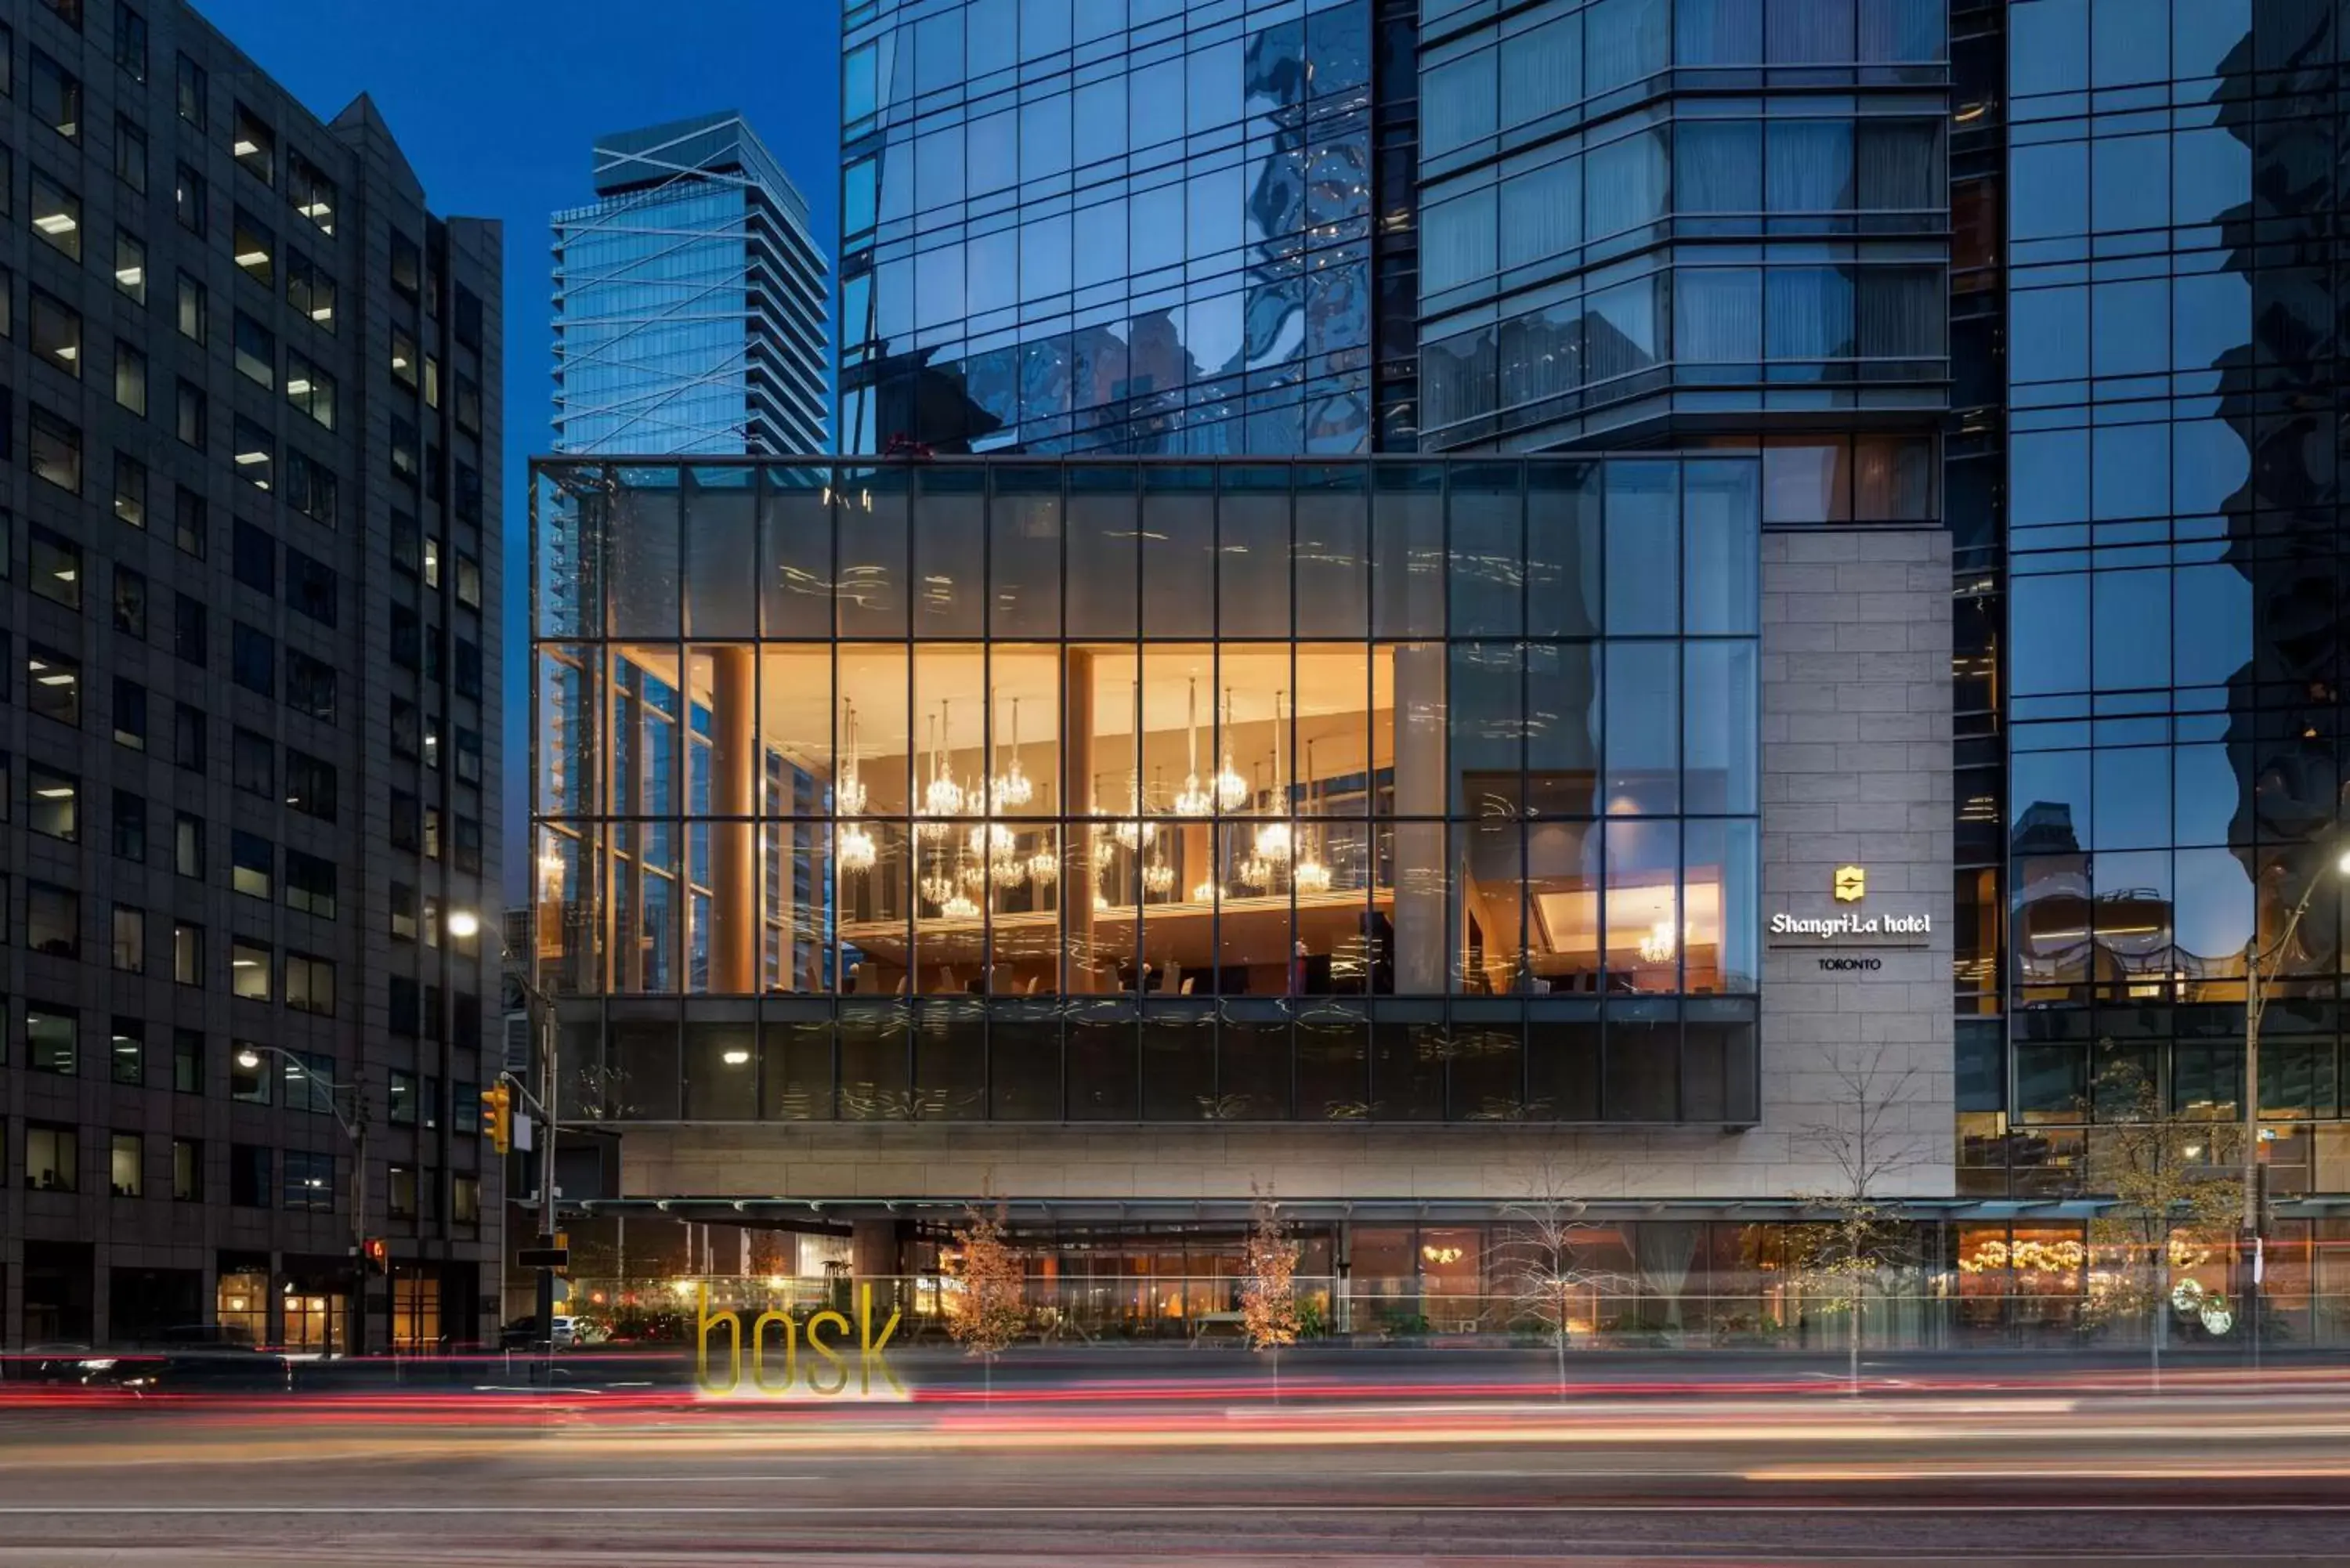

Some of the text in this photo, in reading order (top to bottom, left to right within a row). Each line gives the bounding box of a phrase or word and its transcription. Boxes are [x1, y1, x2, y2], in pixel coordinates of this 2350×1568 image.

[1884, 914, 1930, 933] hotel
[1818, 959, 1881, 970] TORONTO
[697, 1281, 906, 1396] bosk
